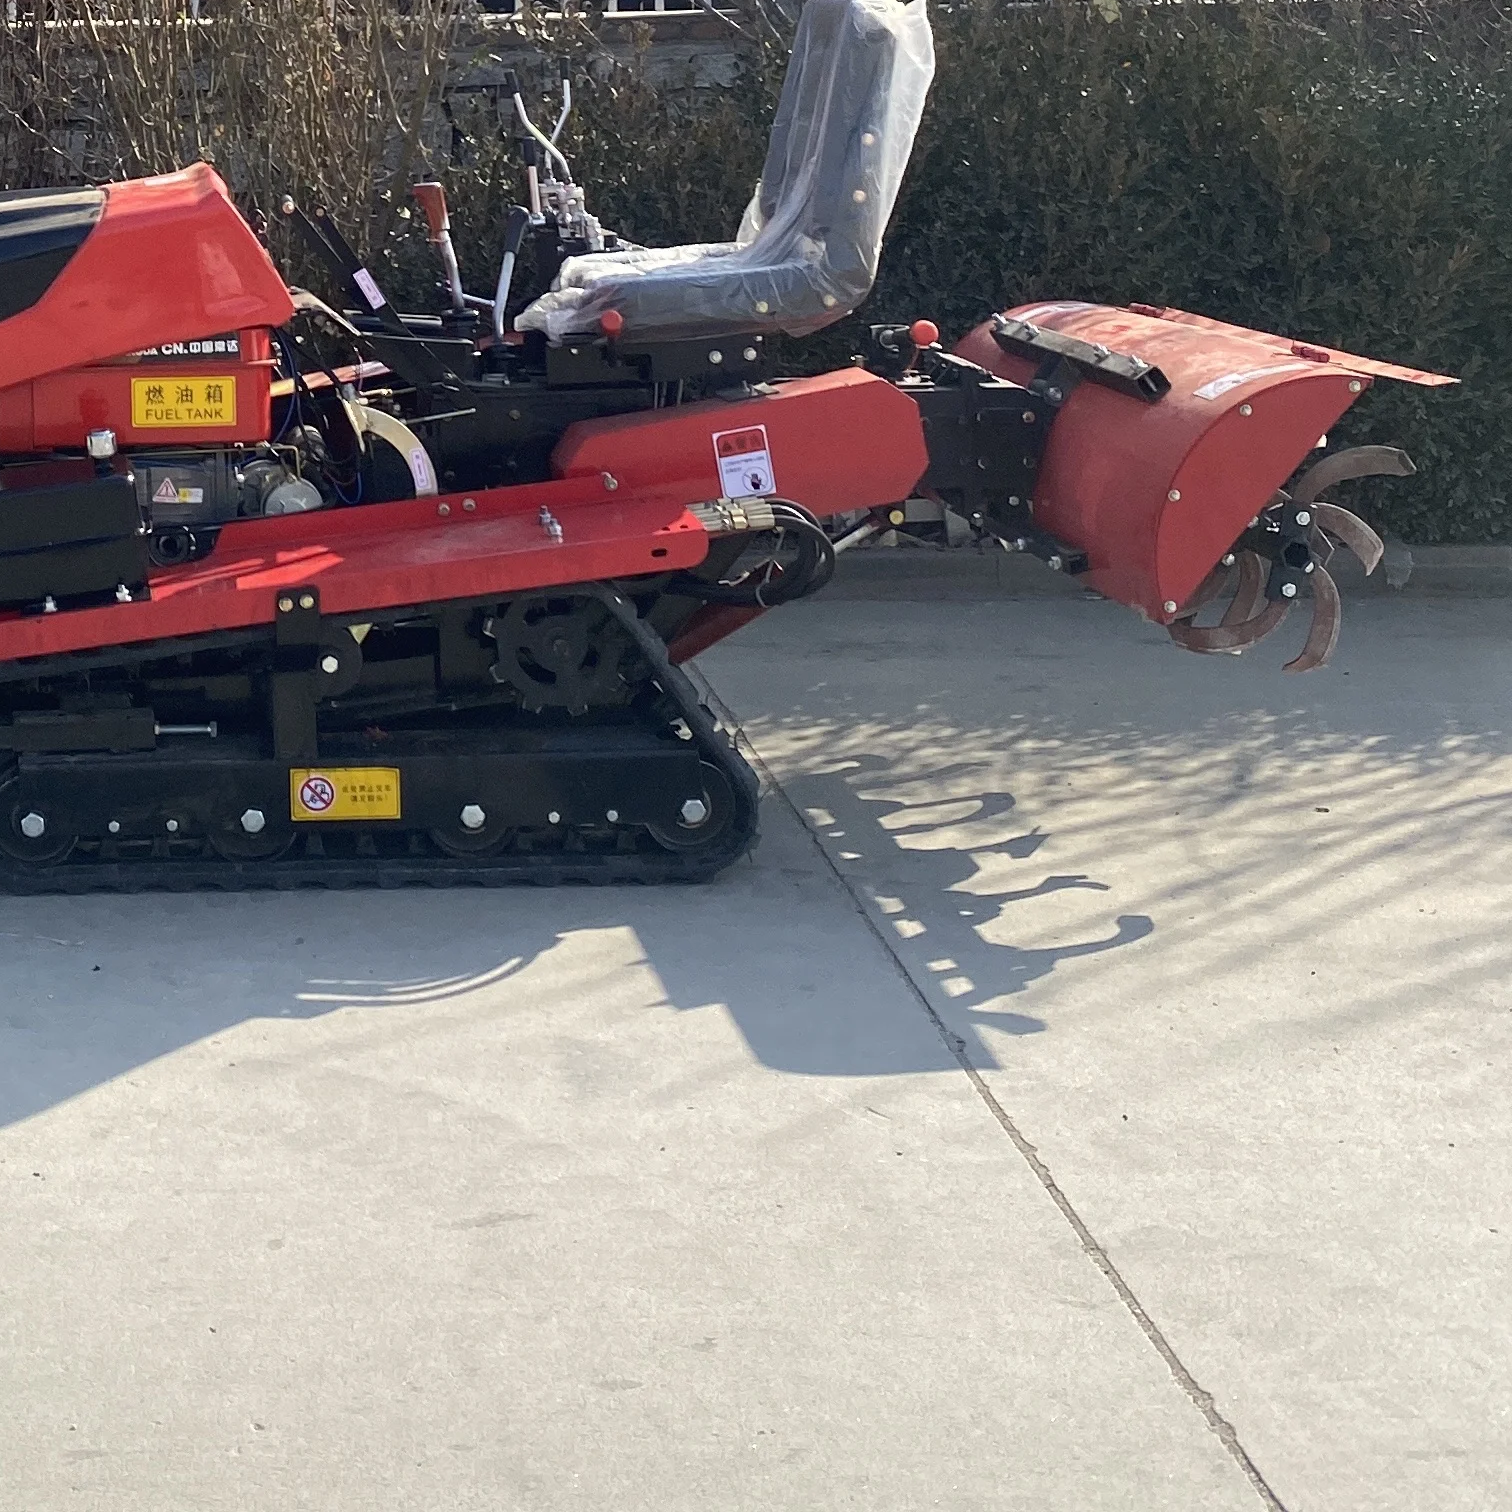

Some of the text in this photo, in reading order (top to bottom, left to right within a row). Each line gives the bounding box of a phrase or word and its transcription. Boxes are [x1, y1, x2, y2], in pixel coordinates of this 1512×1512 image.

[145, 384, 223, 405] 燃油箱
[145, 407, 223, 421] FUEL TANK
